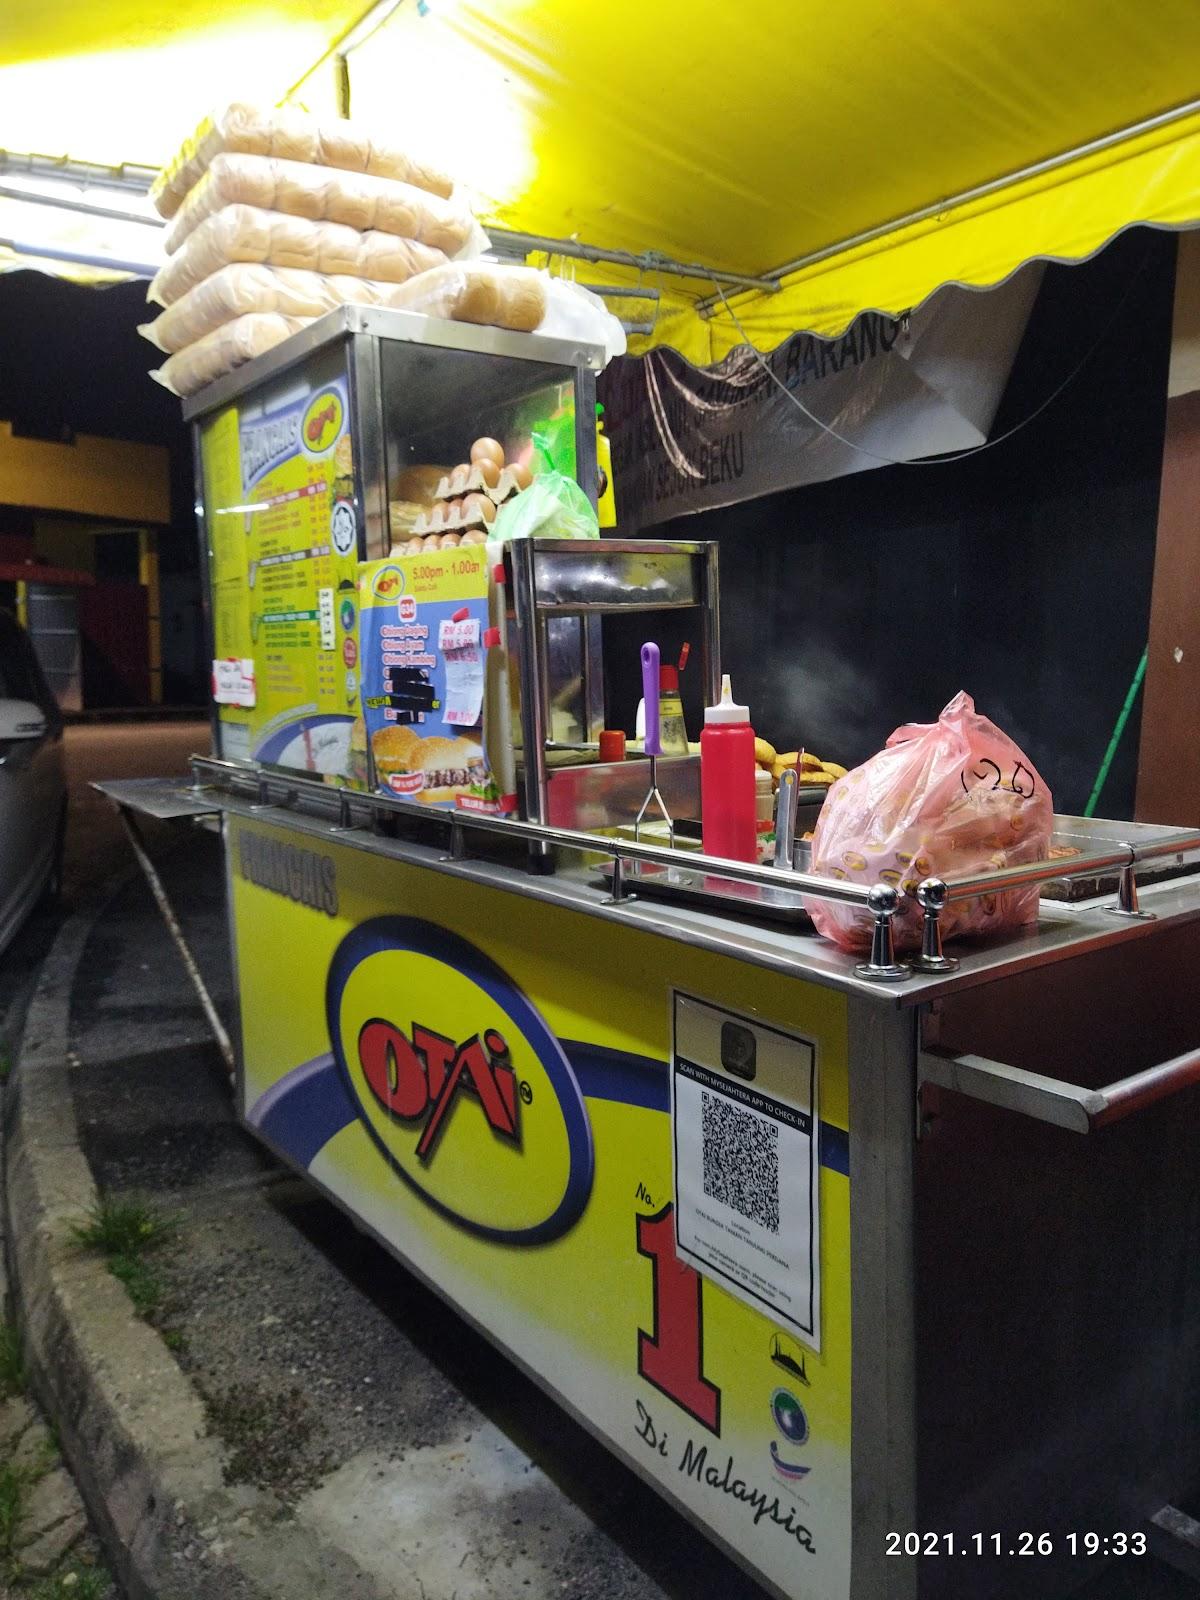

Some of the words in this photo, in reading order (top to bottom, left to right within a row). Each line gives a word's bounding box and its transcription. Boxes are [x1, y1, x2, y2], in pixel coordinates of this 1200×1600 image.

[680, 1063, 694, 1076] SCAN
[696, 1070, 710, 1083] WITH
[710, 1078, 750, 1102] MYSEJAHTERA
[752, 1096, 764, 1107] APP
[765, 1102, 774, 1113] TO
[636, 1201, 721, 1439] 1
[634, 1399, 669, 1458] Di
[677, 1439, 816, 1555] Malaysia
